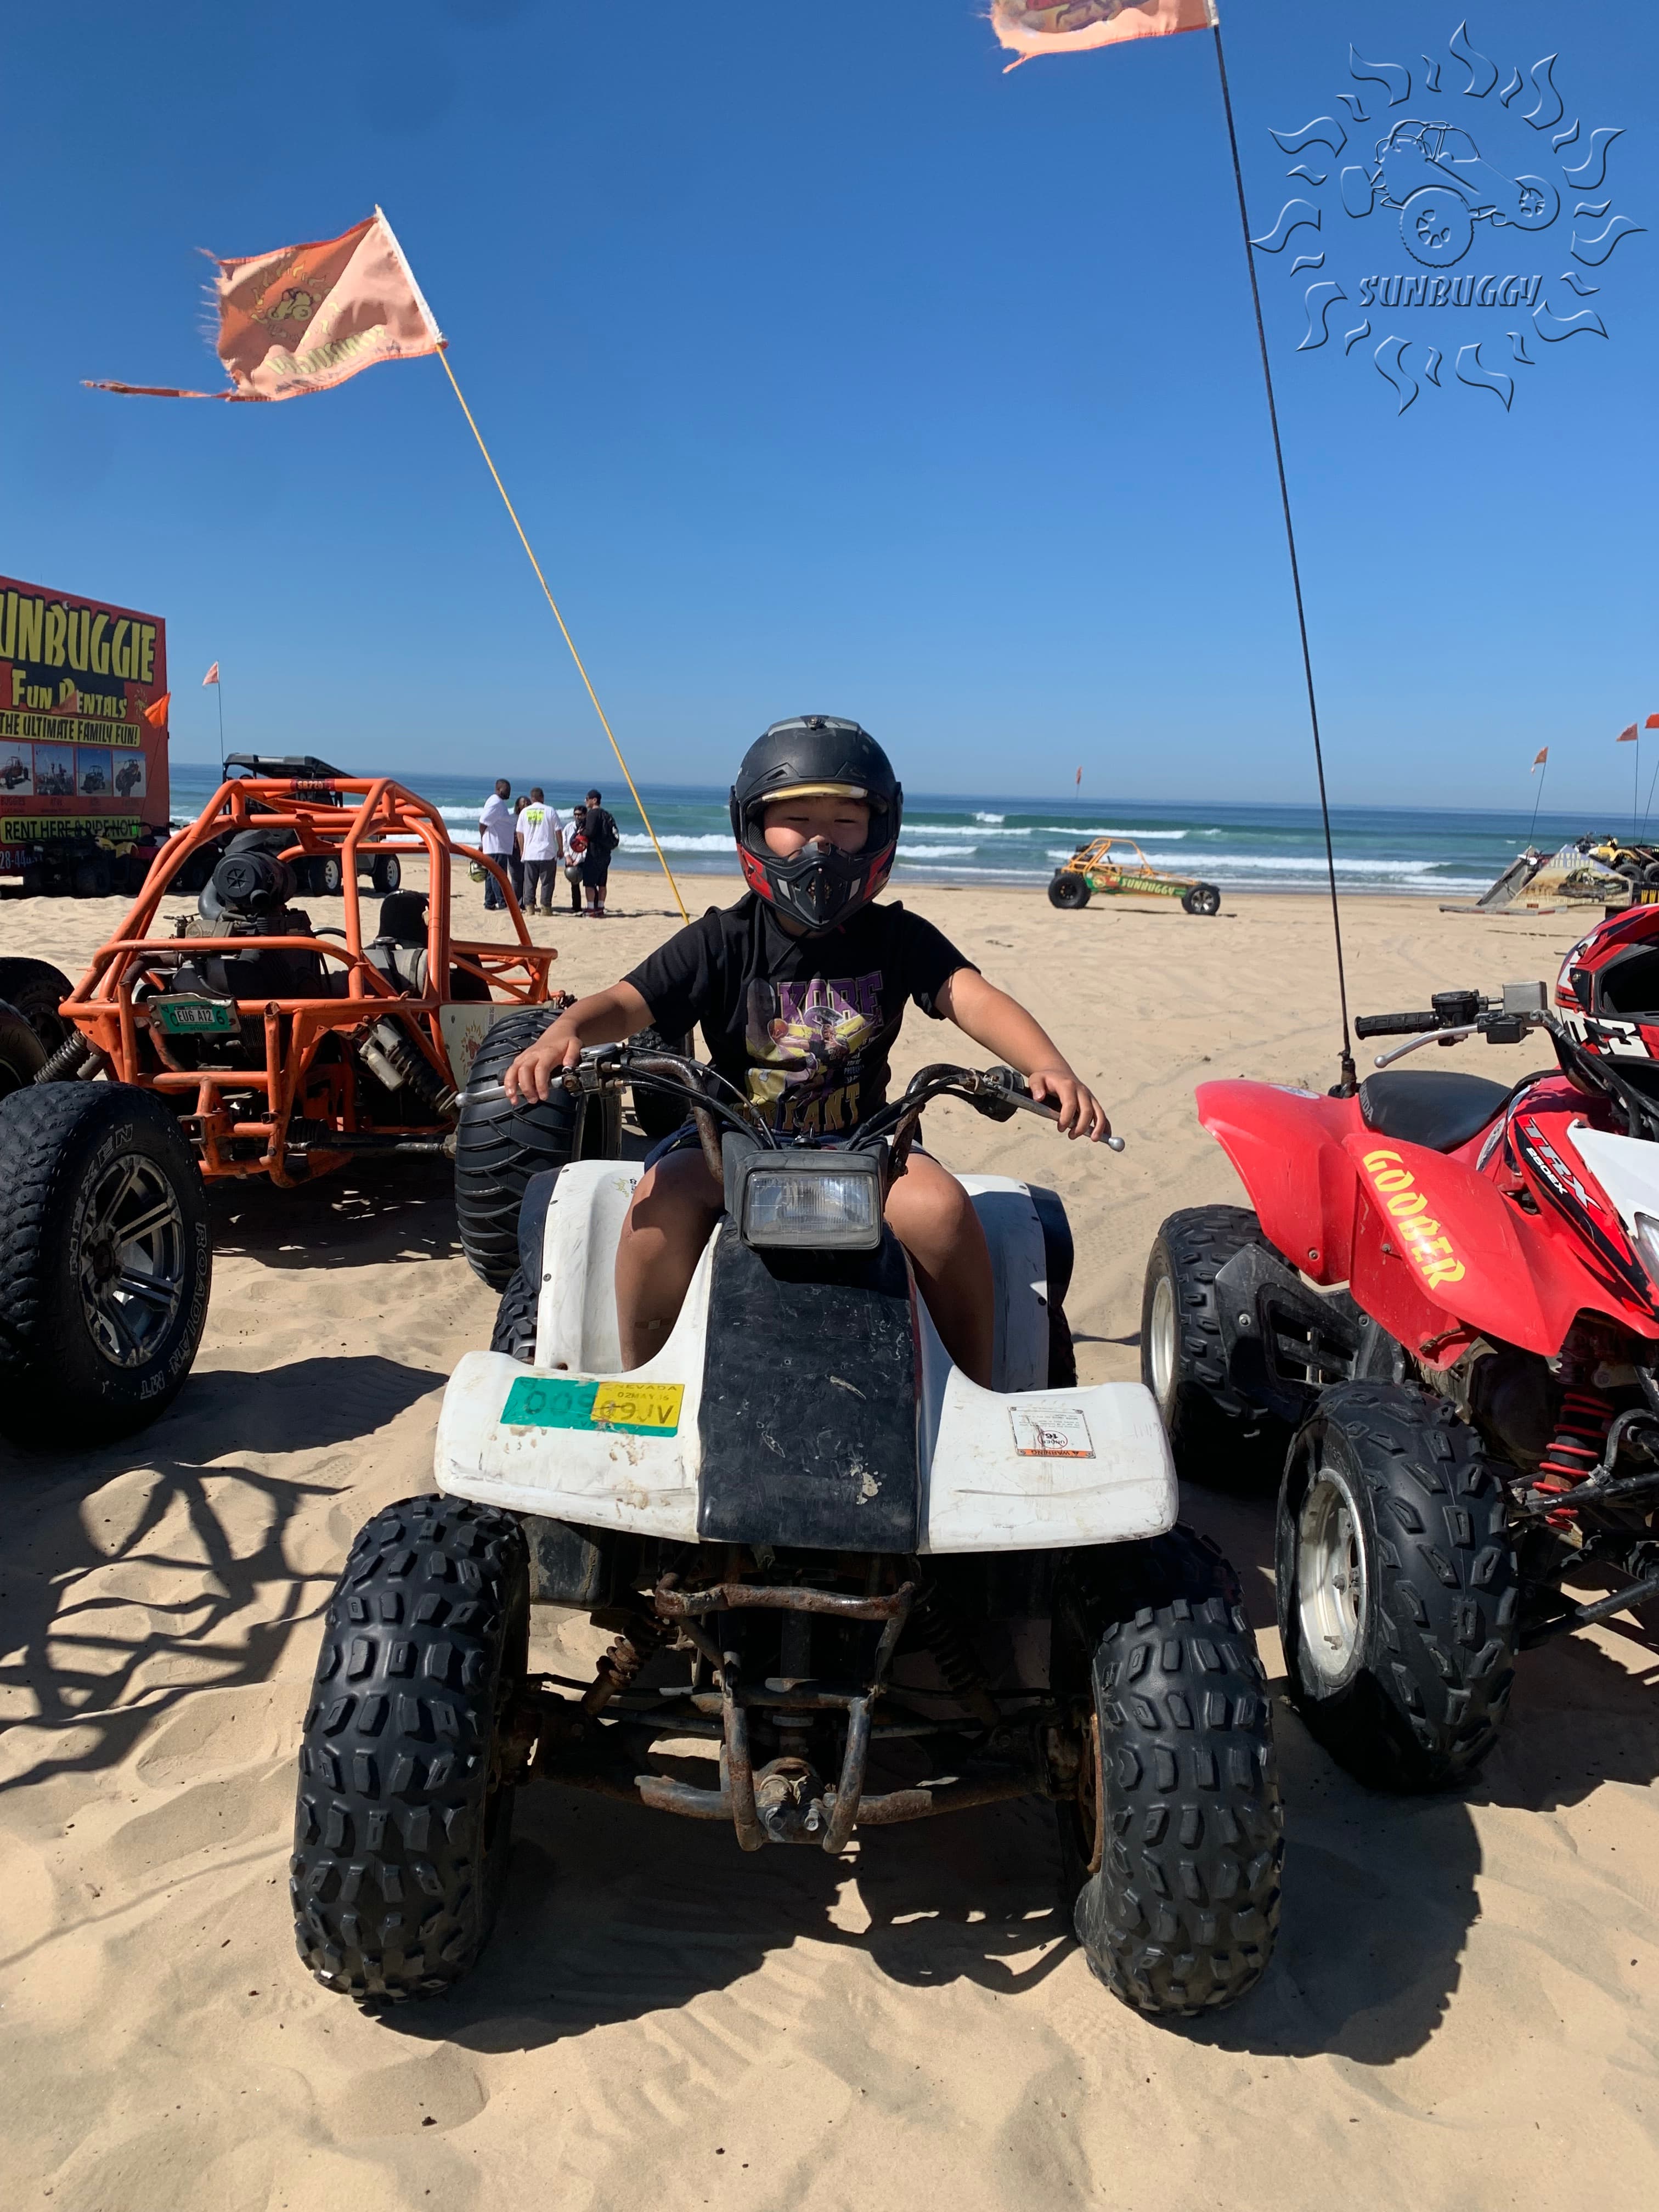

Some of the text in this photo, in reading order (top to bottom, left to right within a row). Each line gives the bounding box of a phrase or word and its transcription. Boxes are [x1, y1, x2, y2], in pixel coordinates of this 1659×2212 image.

[0, 713, 137, 745] THE ULTIMATE FAMILY FUN!
[4, 821, 38, 840] RENT
[41, 820, 71, 839] HERE
[1121, 877, 1176, 896] SUNBUGGY
[776, 970, 884, 1028] KOBE
[178, 1009, 213, 1022] EU6 A12
[1525, 1117, 1602, 1210] TRX
[1363, 1150, 1466, 1290] GOOBER
[613, 1383, 678, 1391] NEVADA
